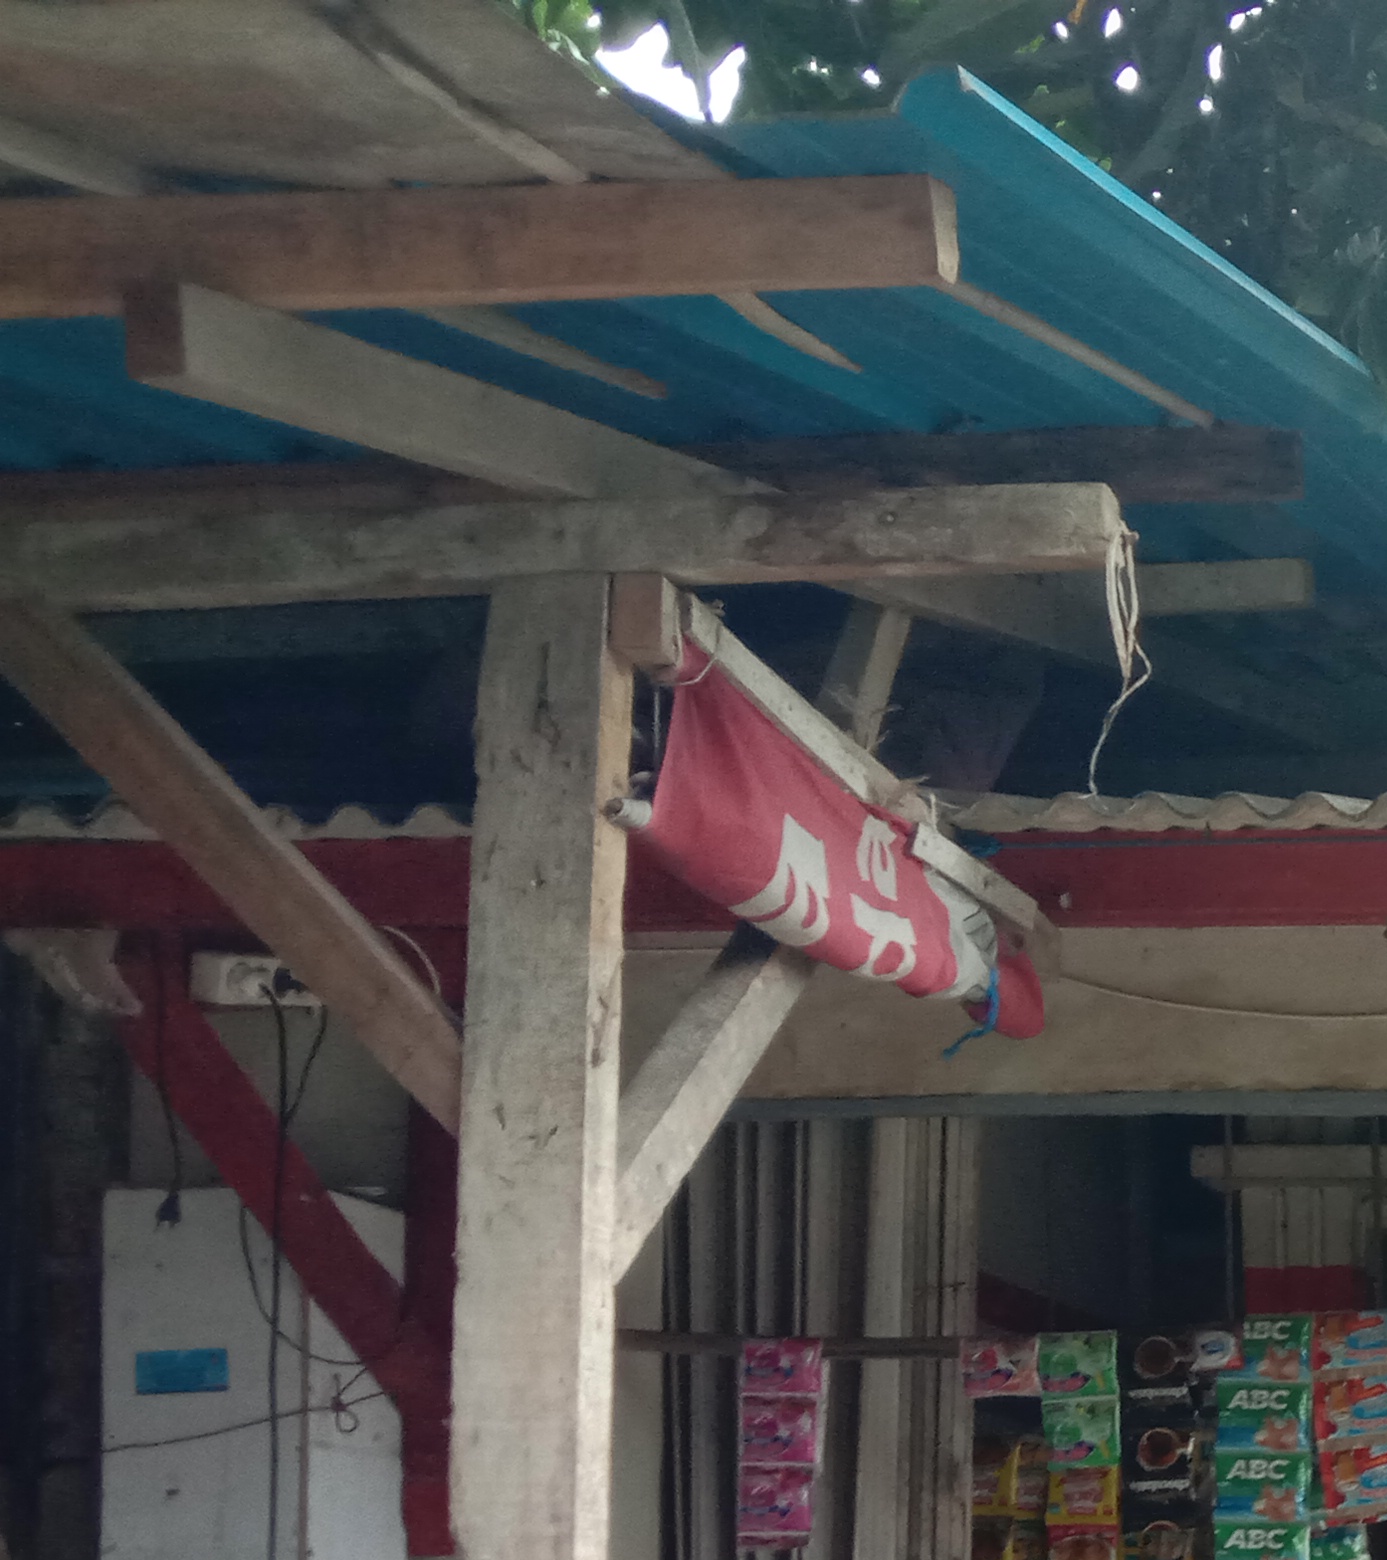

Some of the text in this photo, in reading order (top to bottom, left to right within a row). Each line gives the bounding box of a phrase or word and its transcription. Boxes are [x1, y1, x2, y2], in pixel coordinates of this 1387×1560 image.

[1227, 1388, 1291, 1411] ABC
[1226, 1458, 1290, 1481] ABC
[1223, 1529, 1288, 1551] ABC
